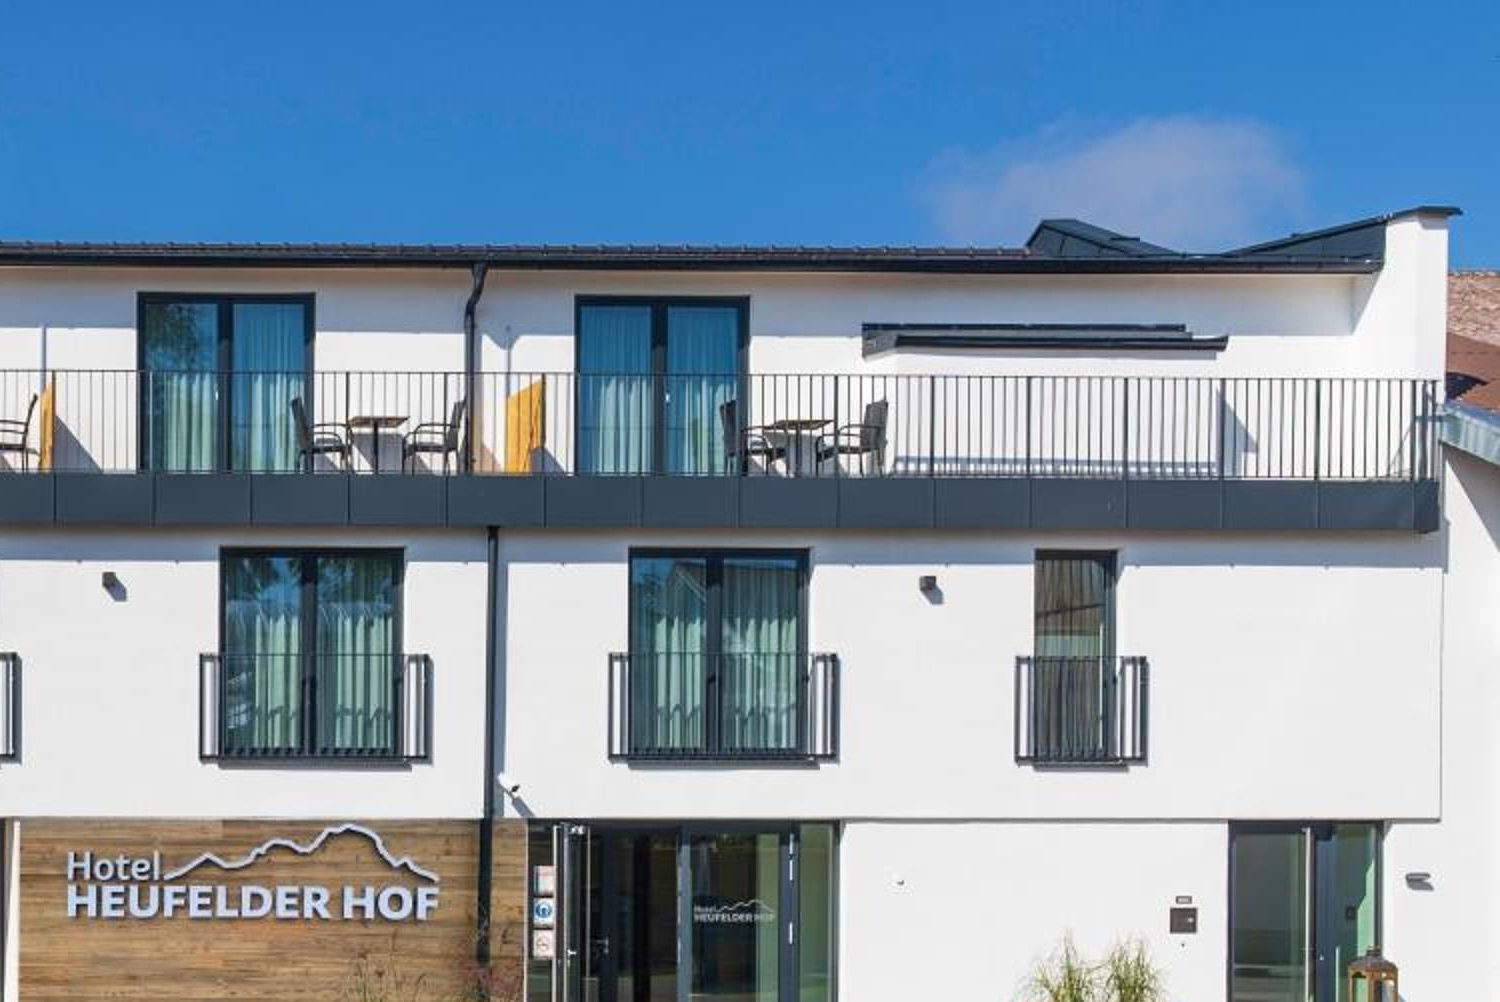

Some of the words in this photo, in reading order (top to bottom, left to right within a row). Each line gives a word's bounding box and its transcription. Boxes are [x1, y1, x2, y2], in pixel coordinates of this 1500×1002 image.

[67, 852, 160, 881] Hotel
[67, 885, 331, 919] HEUFELDER
[342, 886, 440, 920] HOF
